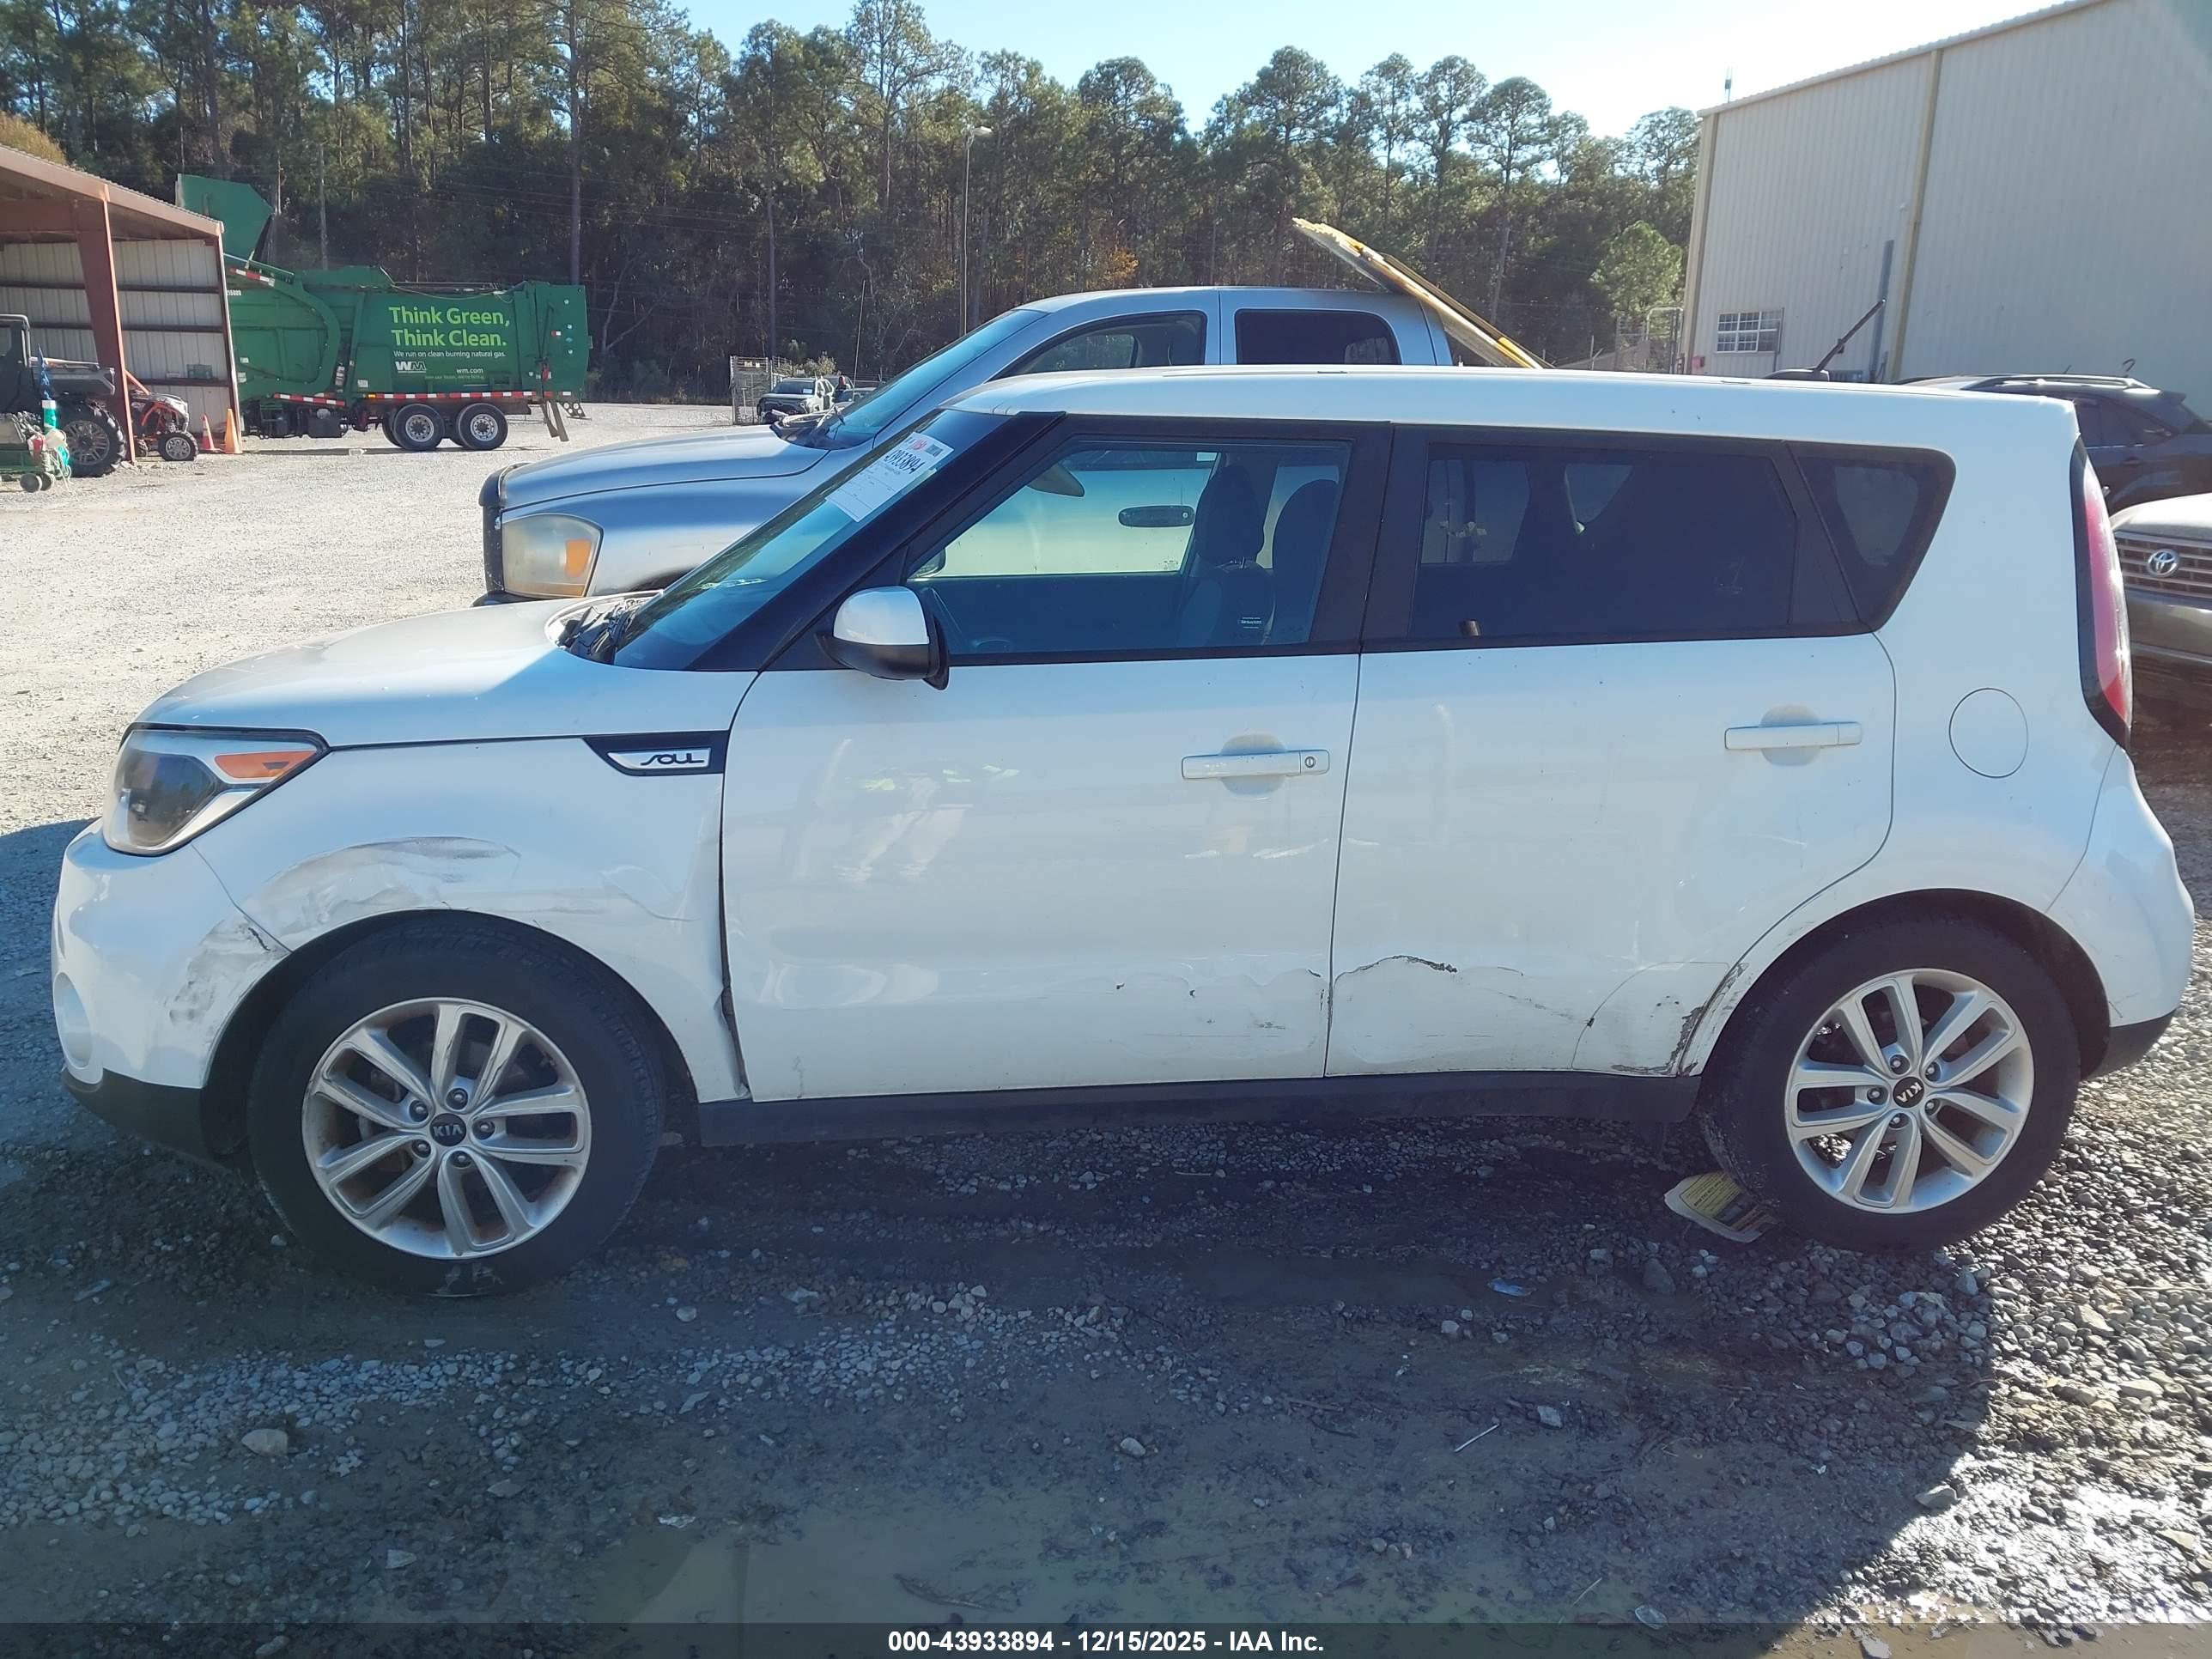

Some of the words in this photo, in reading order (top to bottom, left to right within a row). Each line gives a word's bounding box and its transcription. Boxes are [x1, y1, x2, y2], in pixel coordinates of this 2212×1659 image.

[388, 306, 444, 324] Think
[446, 307, 510, 326] Green,
[391, 328, 446, 346] Think
[448, 329, 507, 346] Clean.
[445, 350, 471, 359] burning
[395, 361, 427, 371] WM
[640, 752, 705, 766] SOUL
[1896, 1081, 1923, 1103] KIA
[432, 1124, 463, 1137] KIA
